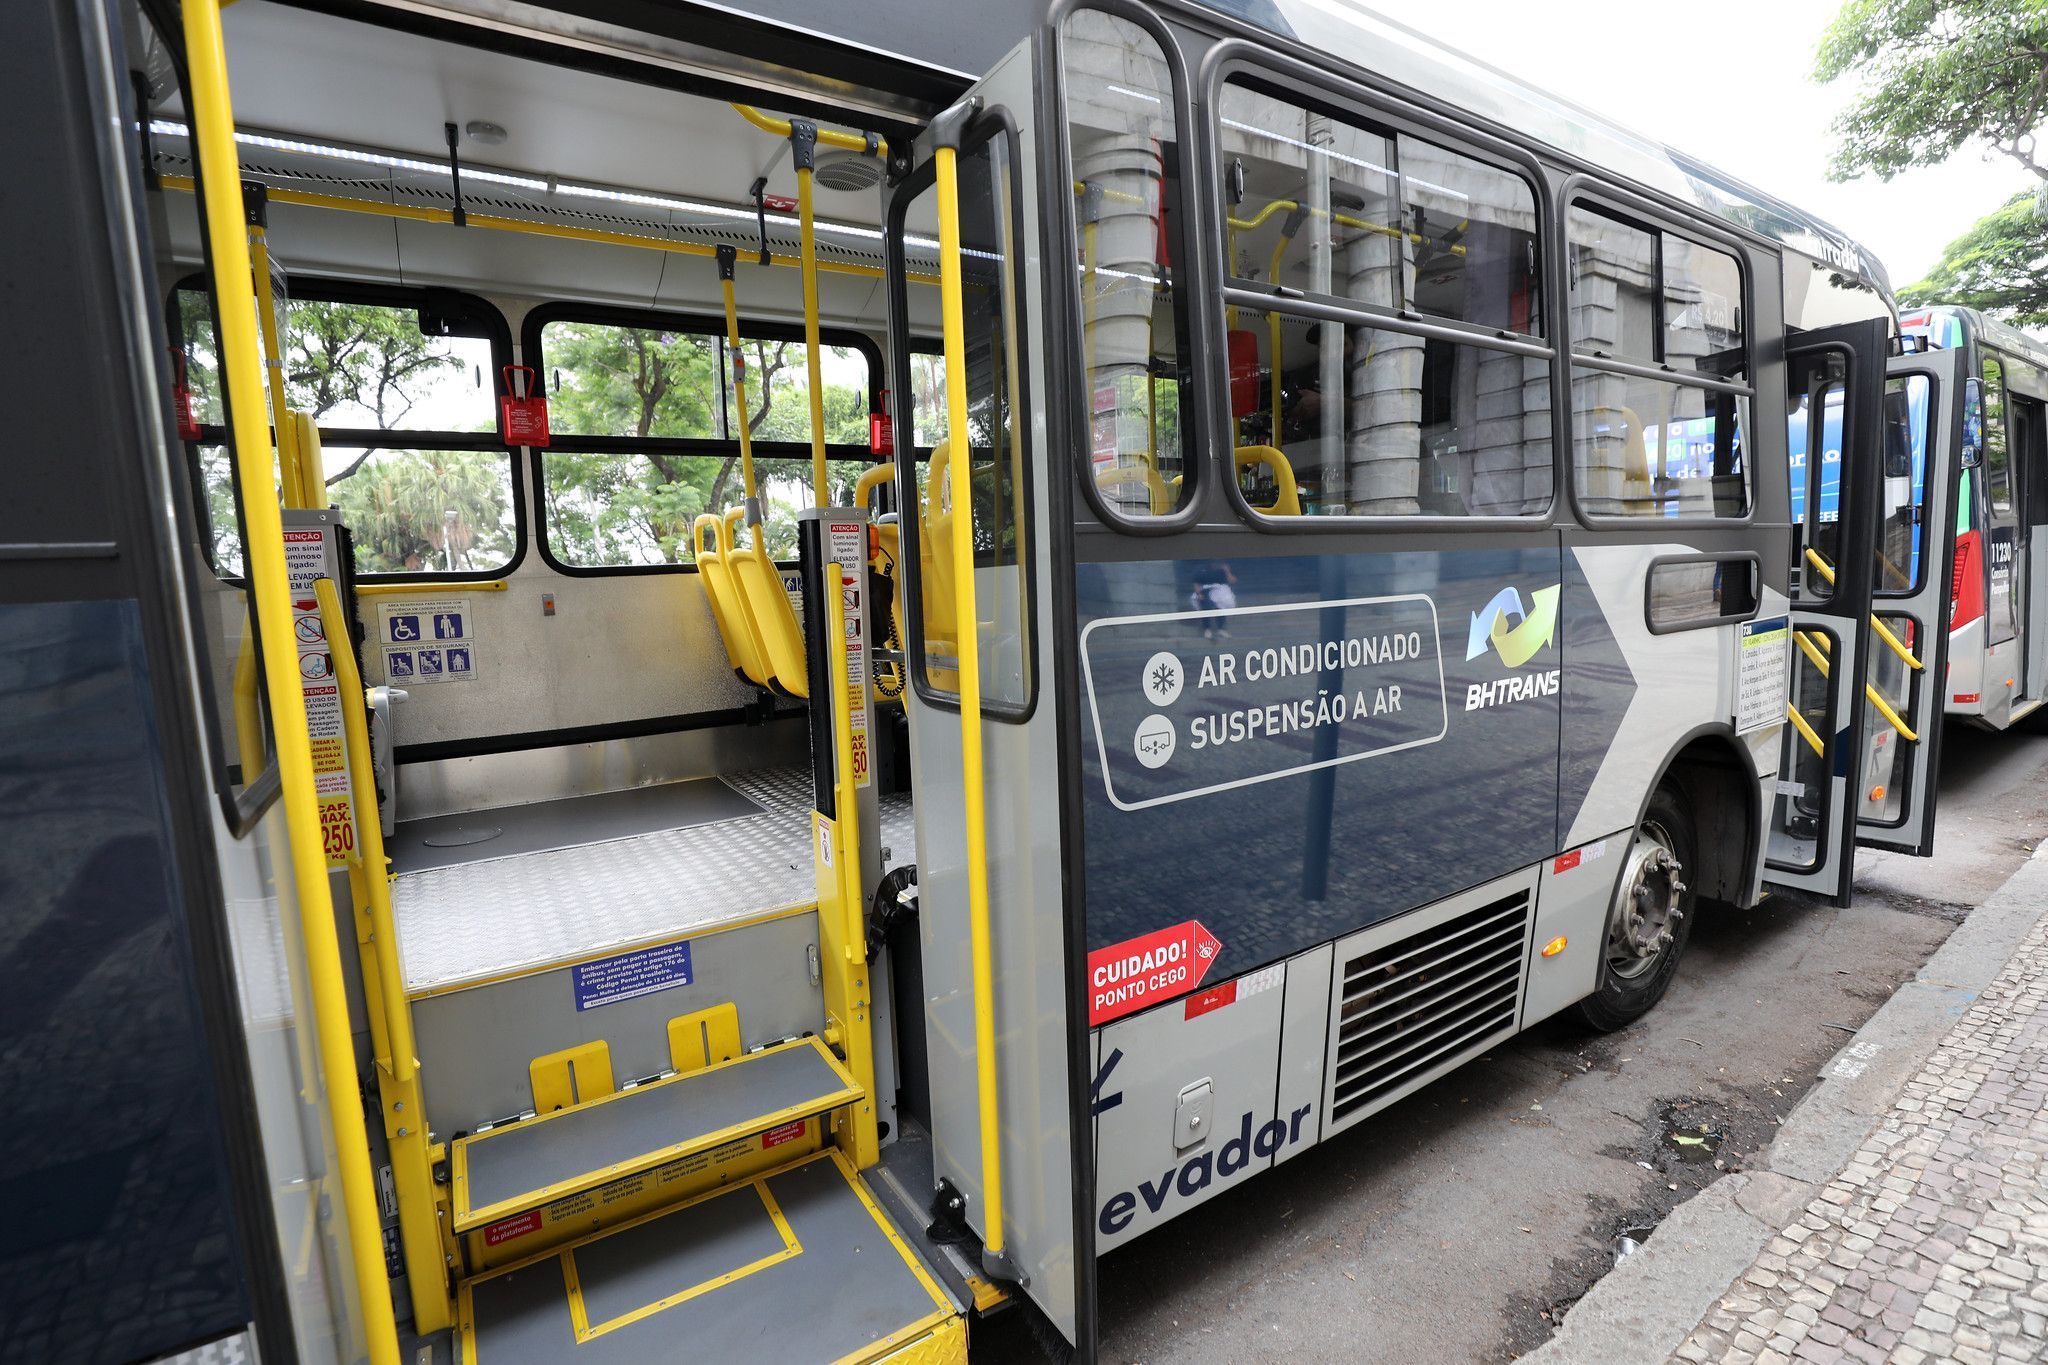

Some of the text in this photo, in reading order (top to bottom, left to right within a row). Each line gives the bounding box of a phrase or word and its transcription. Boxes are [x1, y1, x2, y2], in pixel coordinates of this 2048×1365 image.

[1991, 542, 2011, 563] 11230
[386, 645, 425, 653] DISPOSITIVOS
[435, 642, 470, 650] SEGURANÇA
[1198, 631, 1421, 688] AR CONDICIONADO
[1464, 670, 1560, 711] BHTRANS
[1191, 685, 1402, 750] SUSPENSÃO A AR
[319, 811, 351, 824] MAX.
[321, 823, 354, 853] 250
[581, 962, 612, 973] Embarcar
[614, 958, 628, 966] pela
[629, 954, 647, 963] porta
[648, 948, 673, 957] traseira
[582, 971, 607, 980] ônibus,
[622, 961, 642, 971] pagar
[649, 953, 683, 965] passagem,
[1093, 939, 1188, 988] CUIDADO!
[587, 976, 605, 985] crime
[606, 970, 632, 981] previsto
[643, 962, 663, 971] artigo
[596, 969, 672, 990] Código Penal Brasileiro.
[620, 981, 645, 991] detenção
[1095, 966, 1187, 1012] PONTO CEGO
[1099, 1102, 1311, 1236] evador
[498, 1216, 531, 1231] movimento
[500, 1223, 535, 1240] plataforma.
